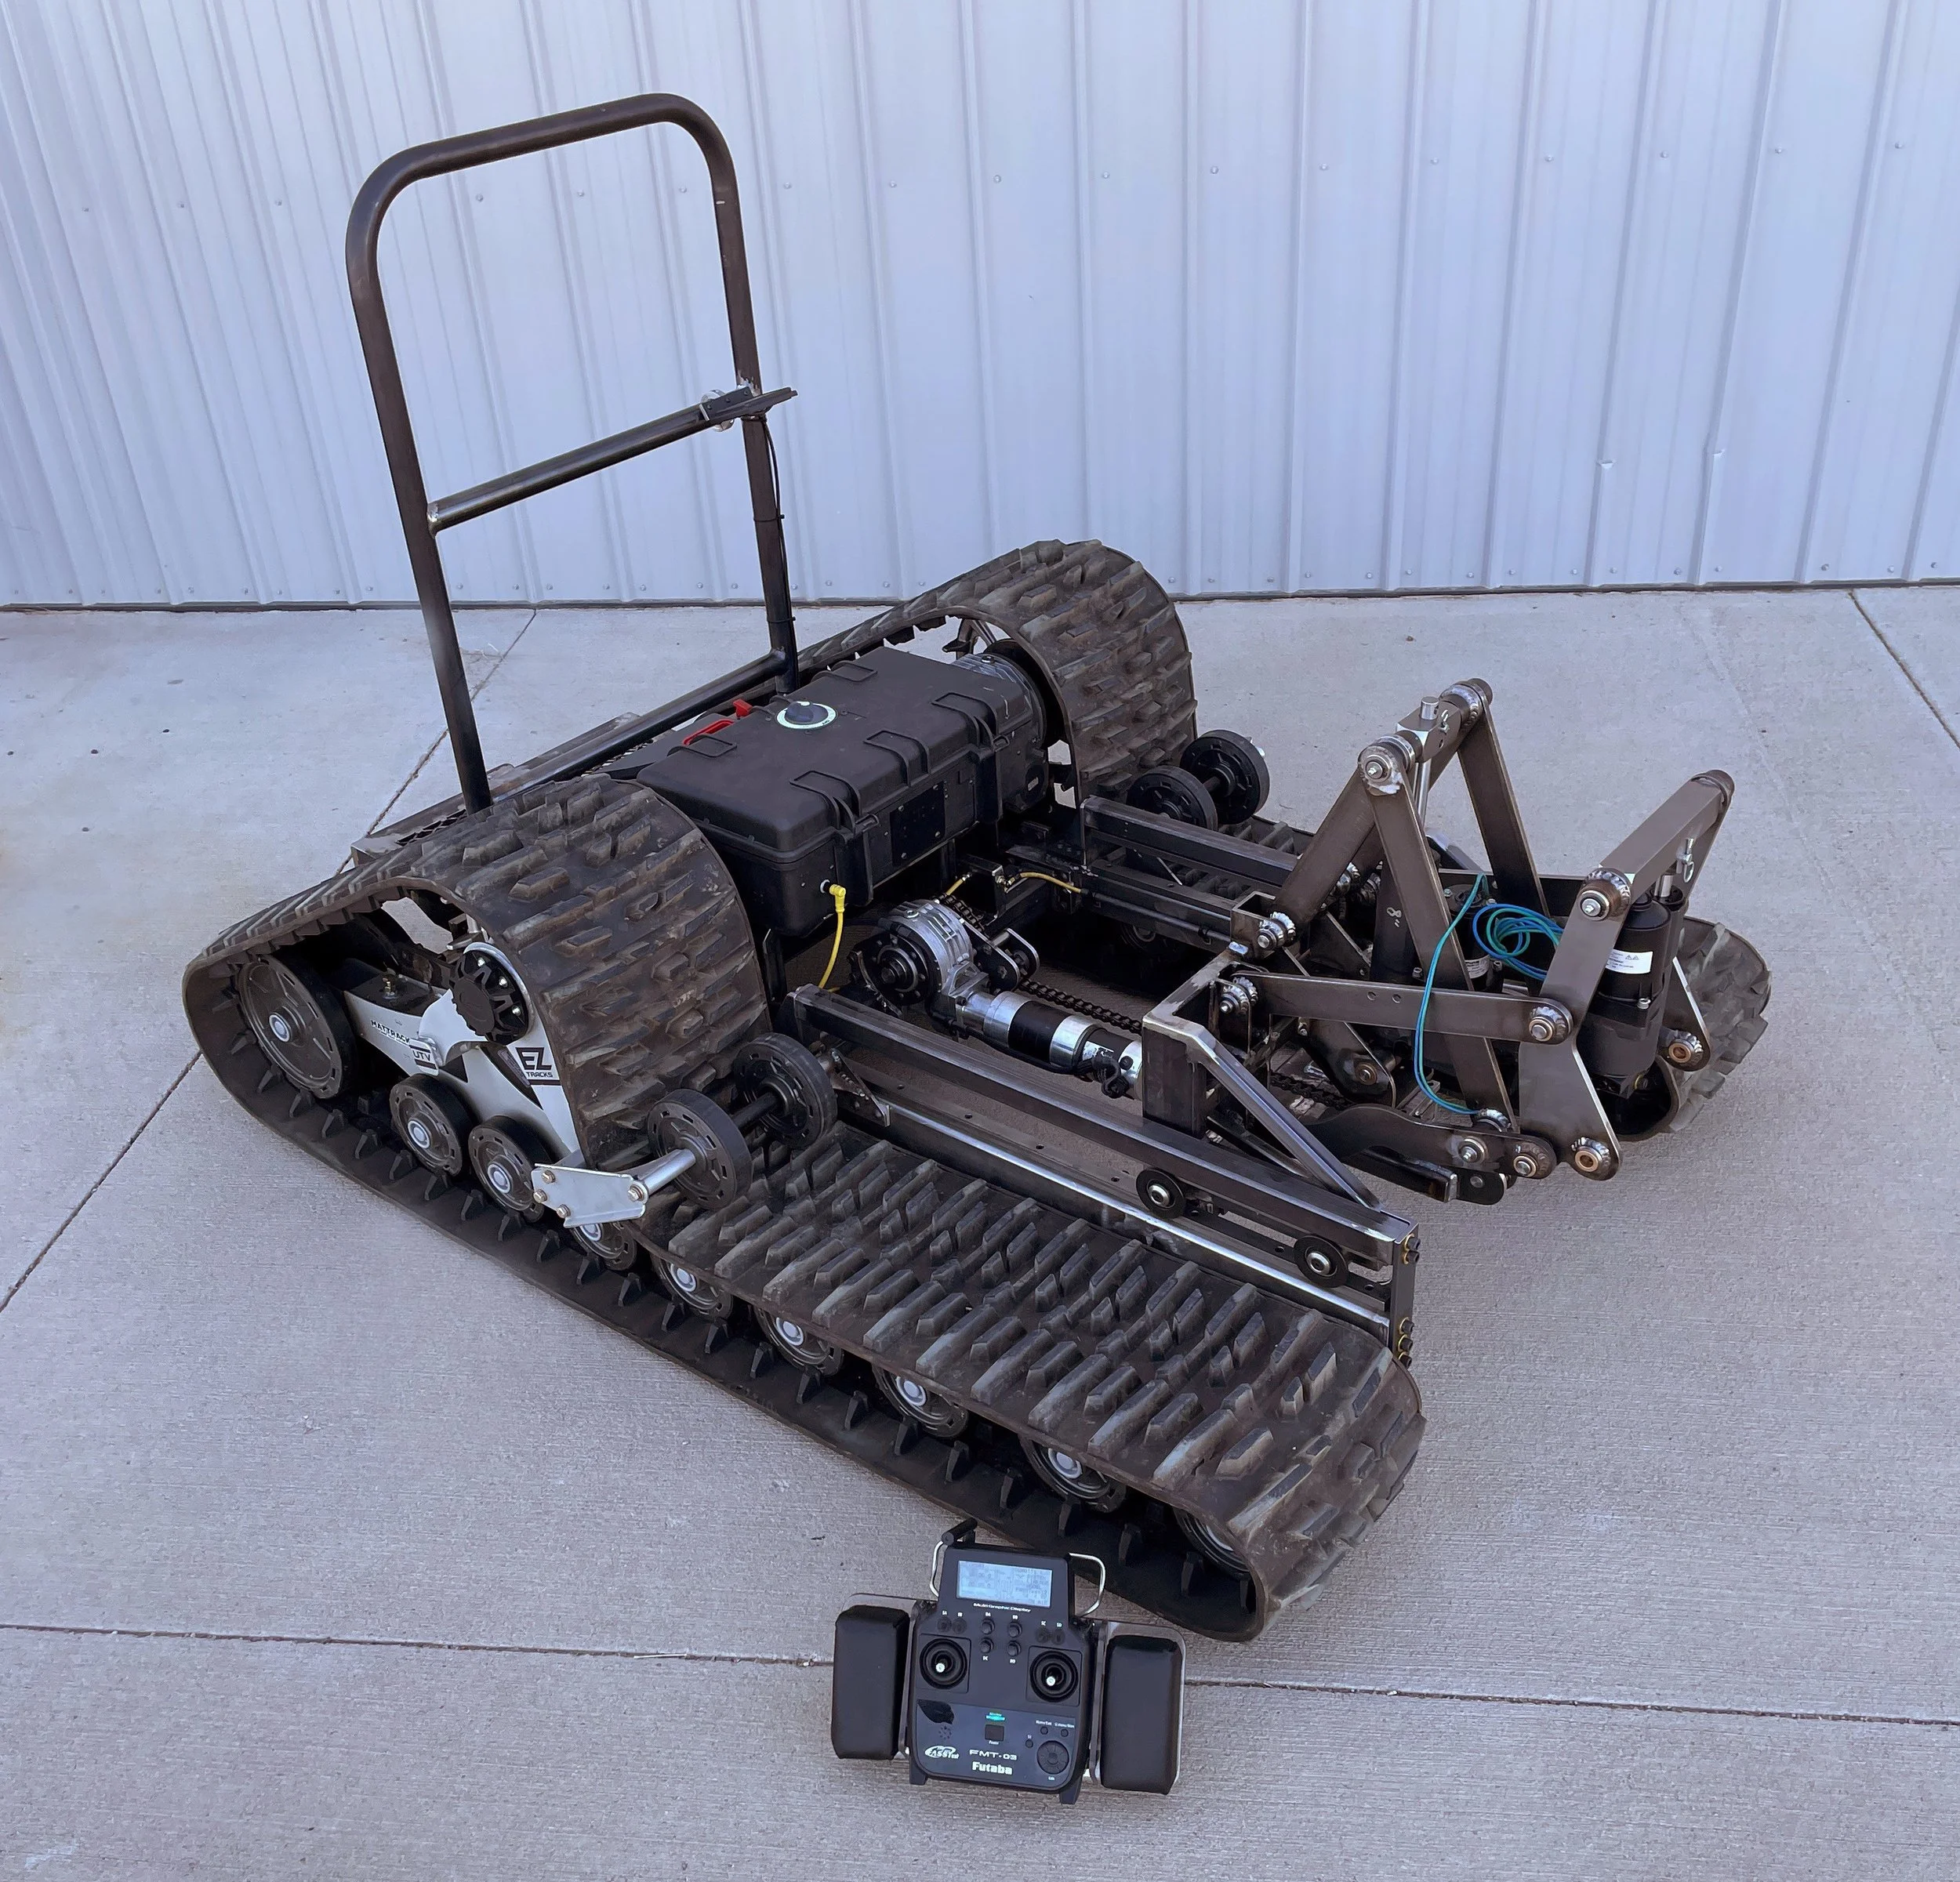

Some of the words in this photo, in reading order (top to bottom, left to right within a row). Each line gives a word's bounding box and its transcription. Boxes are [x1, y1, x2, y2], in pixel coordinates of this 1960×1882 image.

[412, 1050, 430, 1061] UTV
[515, 1047, 552, 1070] EZ
[969, 1749, 1018, 1761] FMT-03
[972, 1761, 1013, 1775] Futaba
